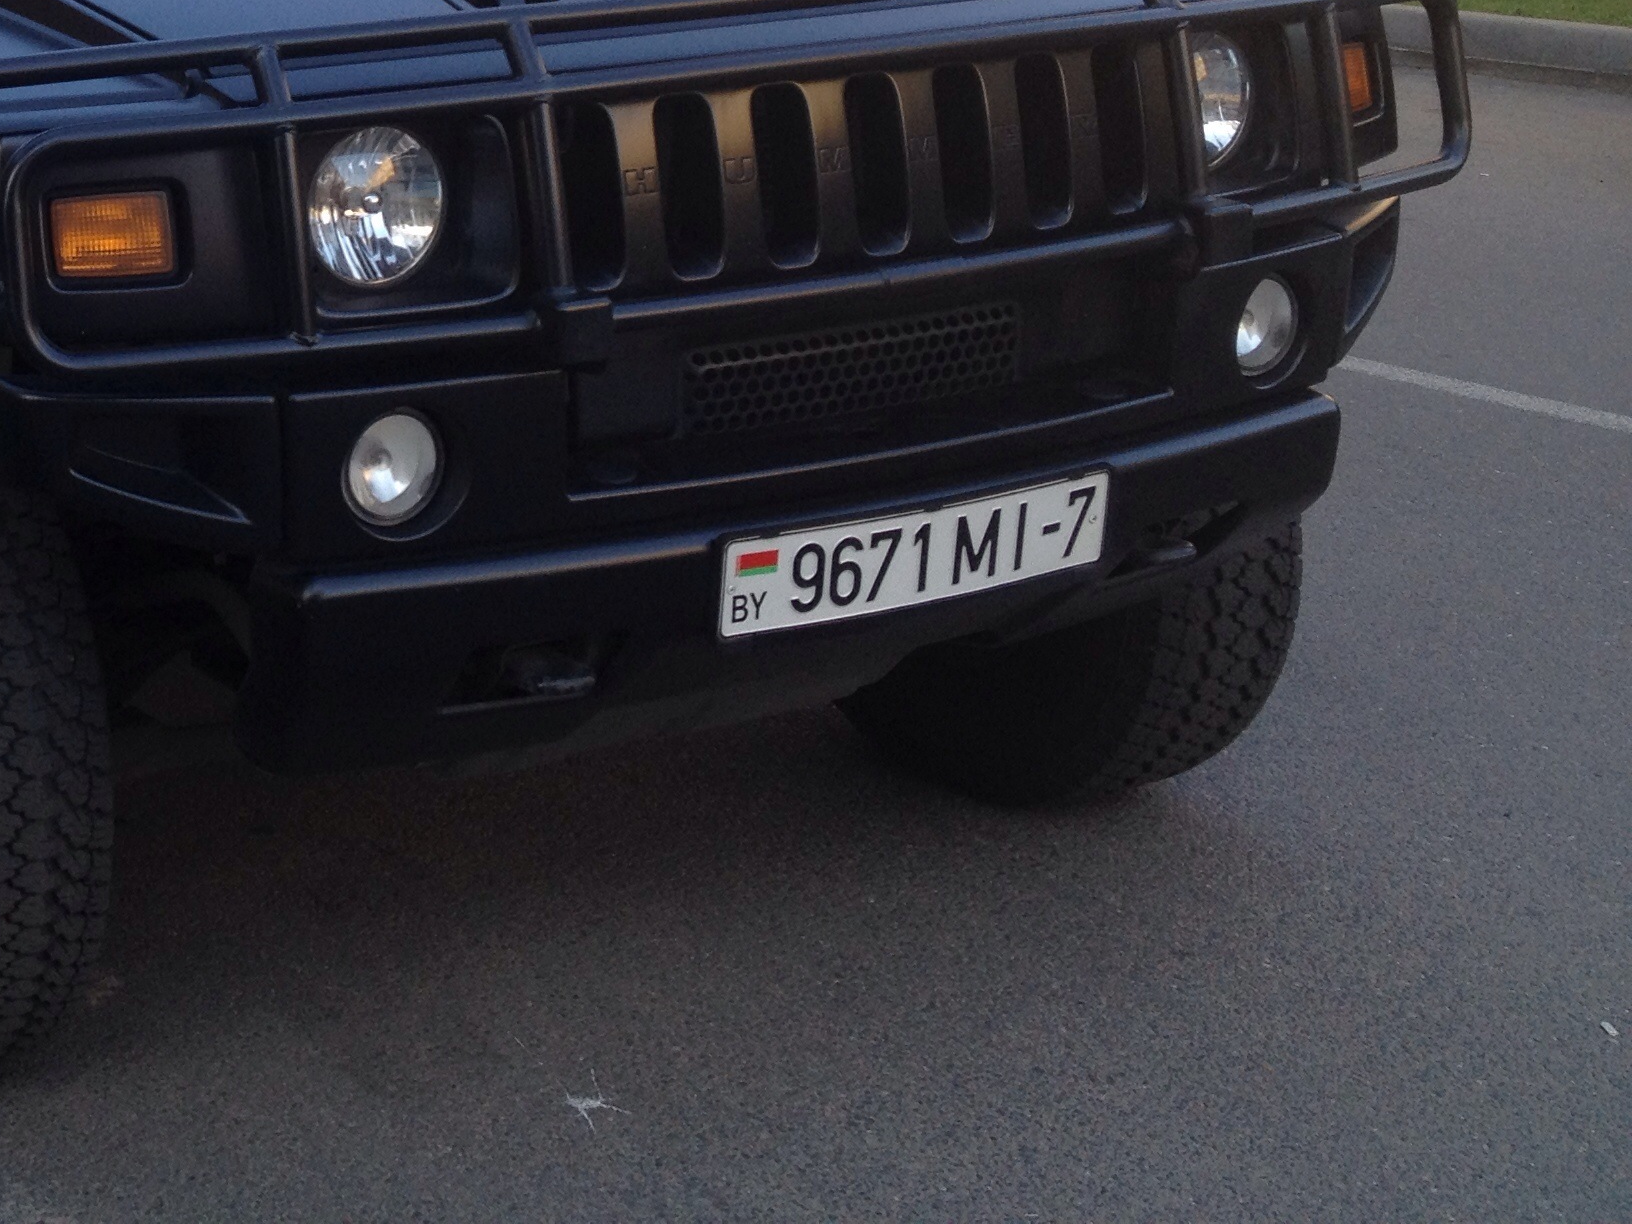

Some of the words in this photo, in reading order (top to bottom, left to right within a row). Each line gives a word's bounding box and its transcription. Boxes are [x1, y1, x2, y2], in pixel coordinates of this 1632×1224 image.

[790, 522, 932, 613] 9671
[950, 485, 1097, 586] MI-7
[731, 590, 767, 623] BY
